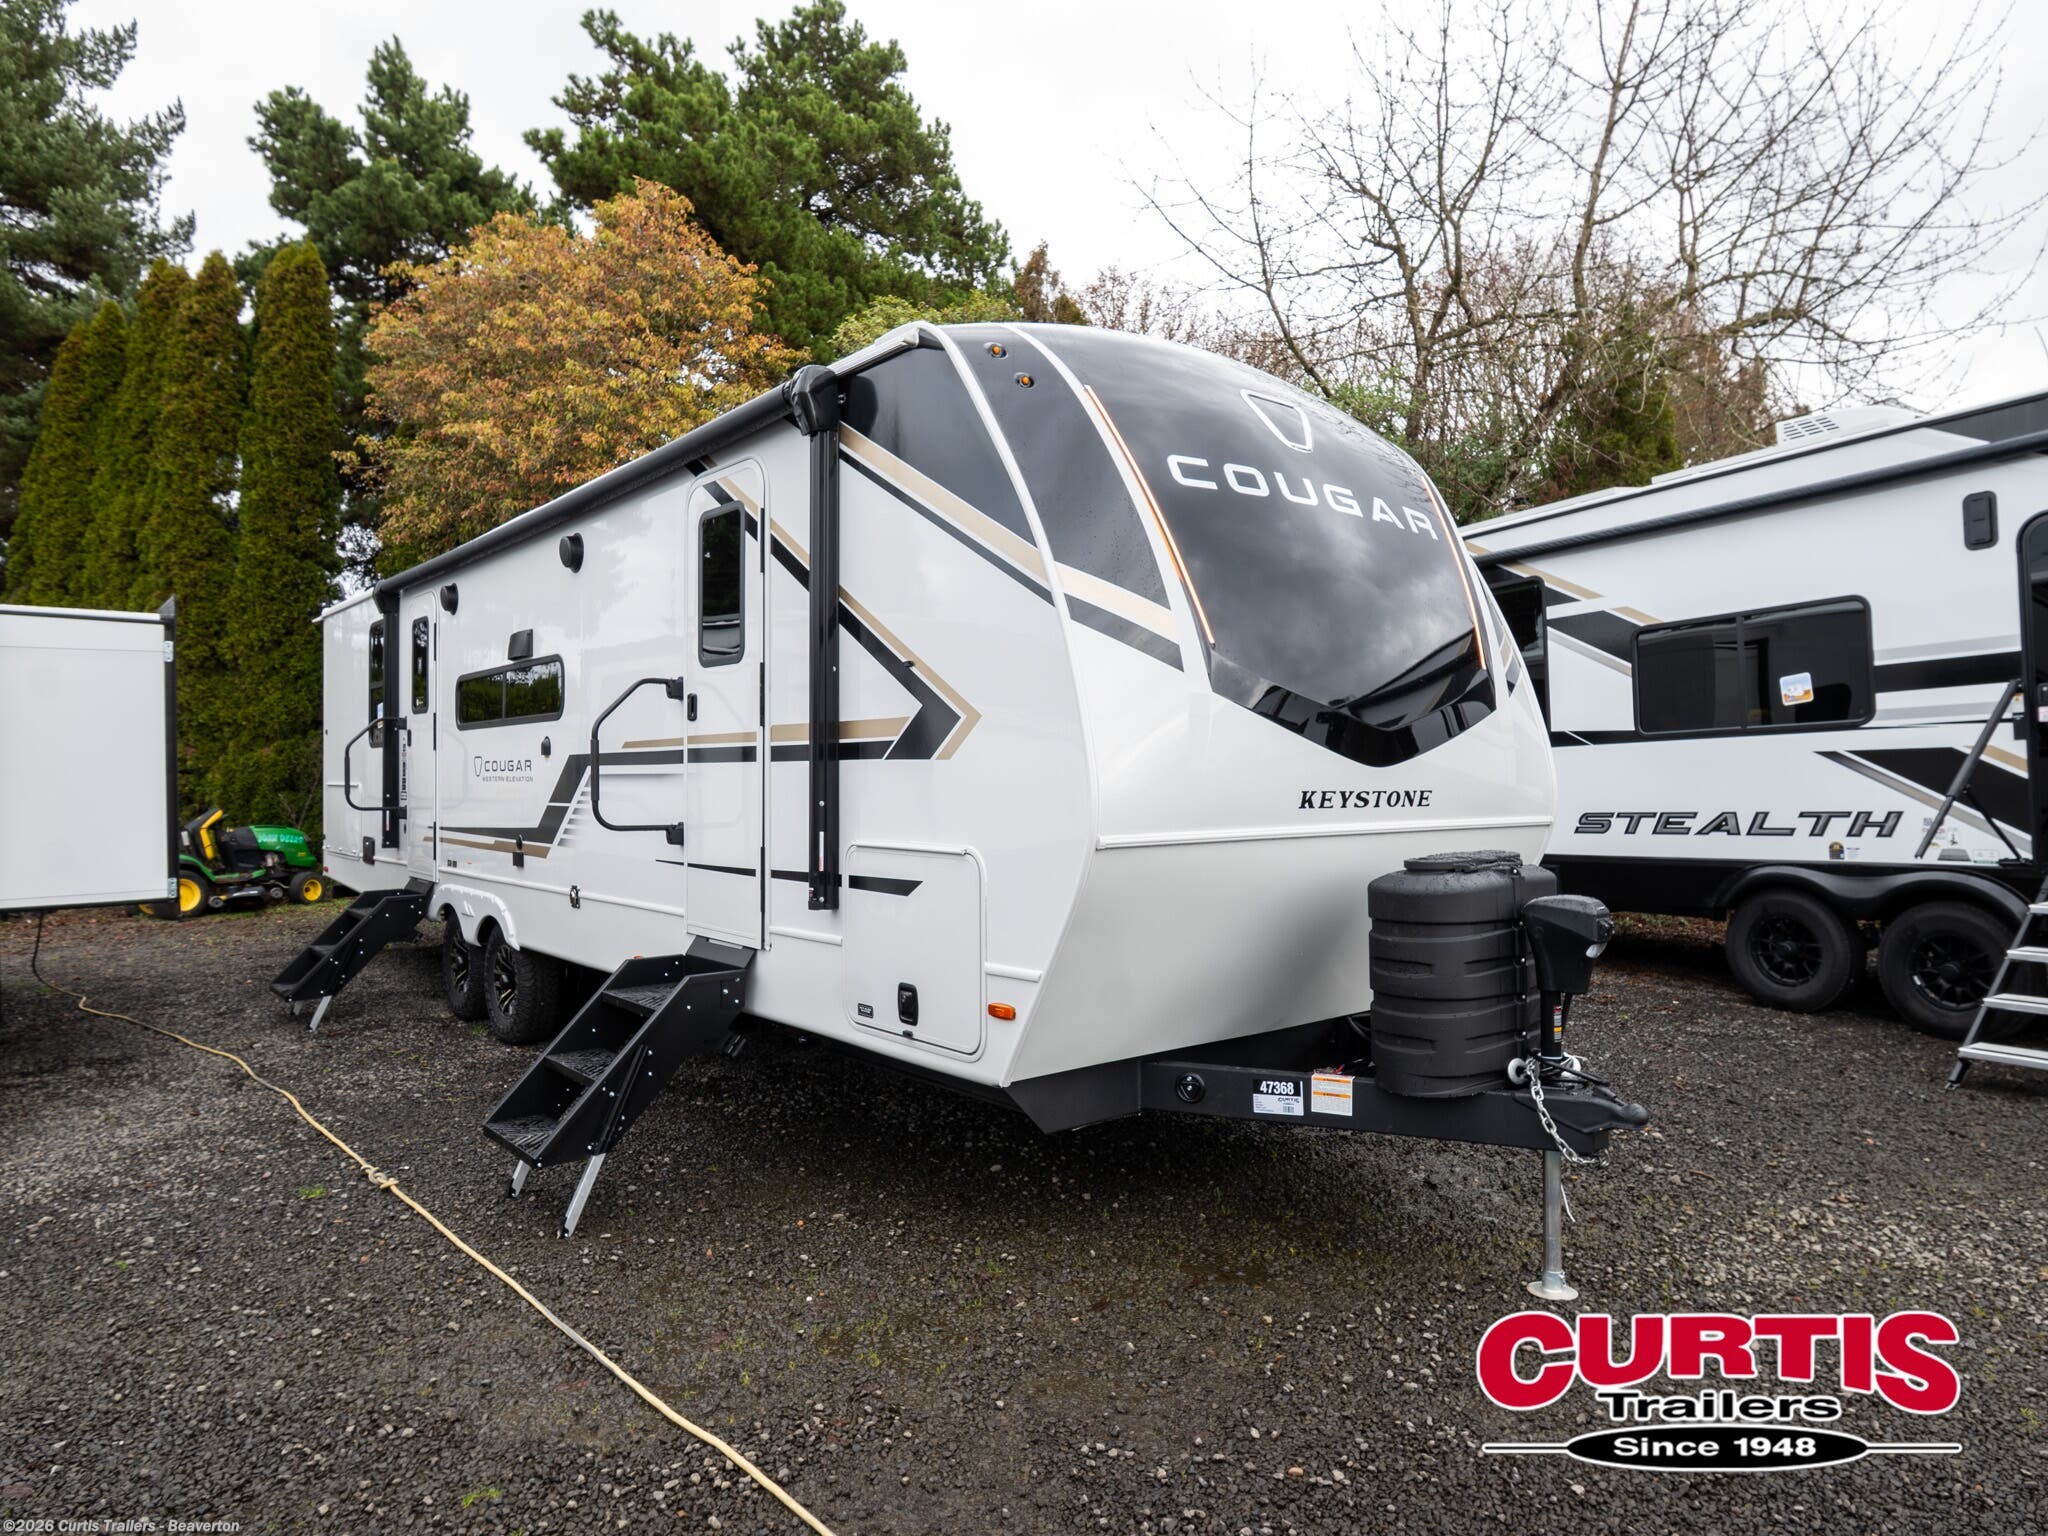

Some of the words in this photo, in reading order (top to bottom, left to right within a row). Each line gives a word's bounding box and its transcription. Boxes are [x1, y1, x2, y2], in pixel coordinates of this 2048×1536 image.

[1167, 455, 1439, 540] COUGAR
[485, 760, 532, 772] COUGAR
[1299, 790, 1433, 809] KEYSTONE
[1574, 811, 1904, 838] STEALTH
[1260, 1081, 1294, 1095] 47368
